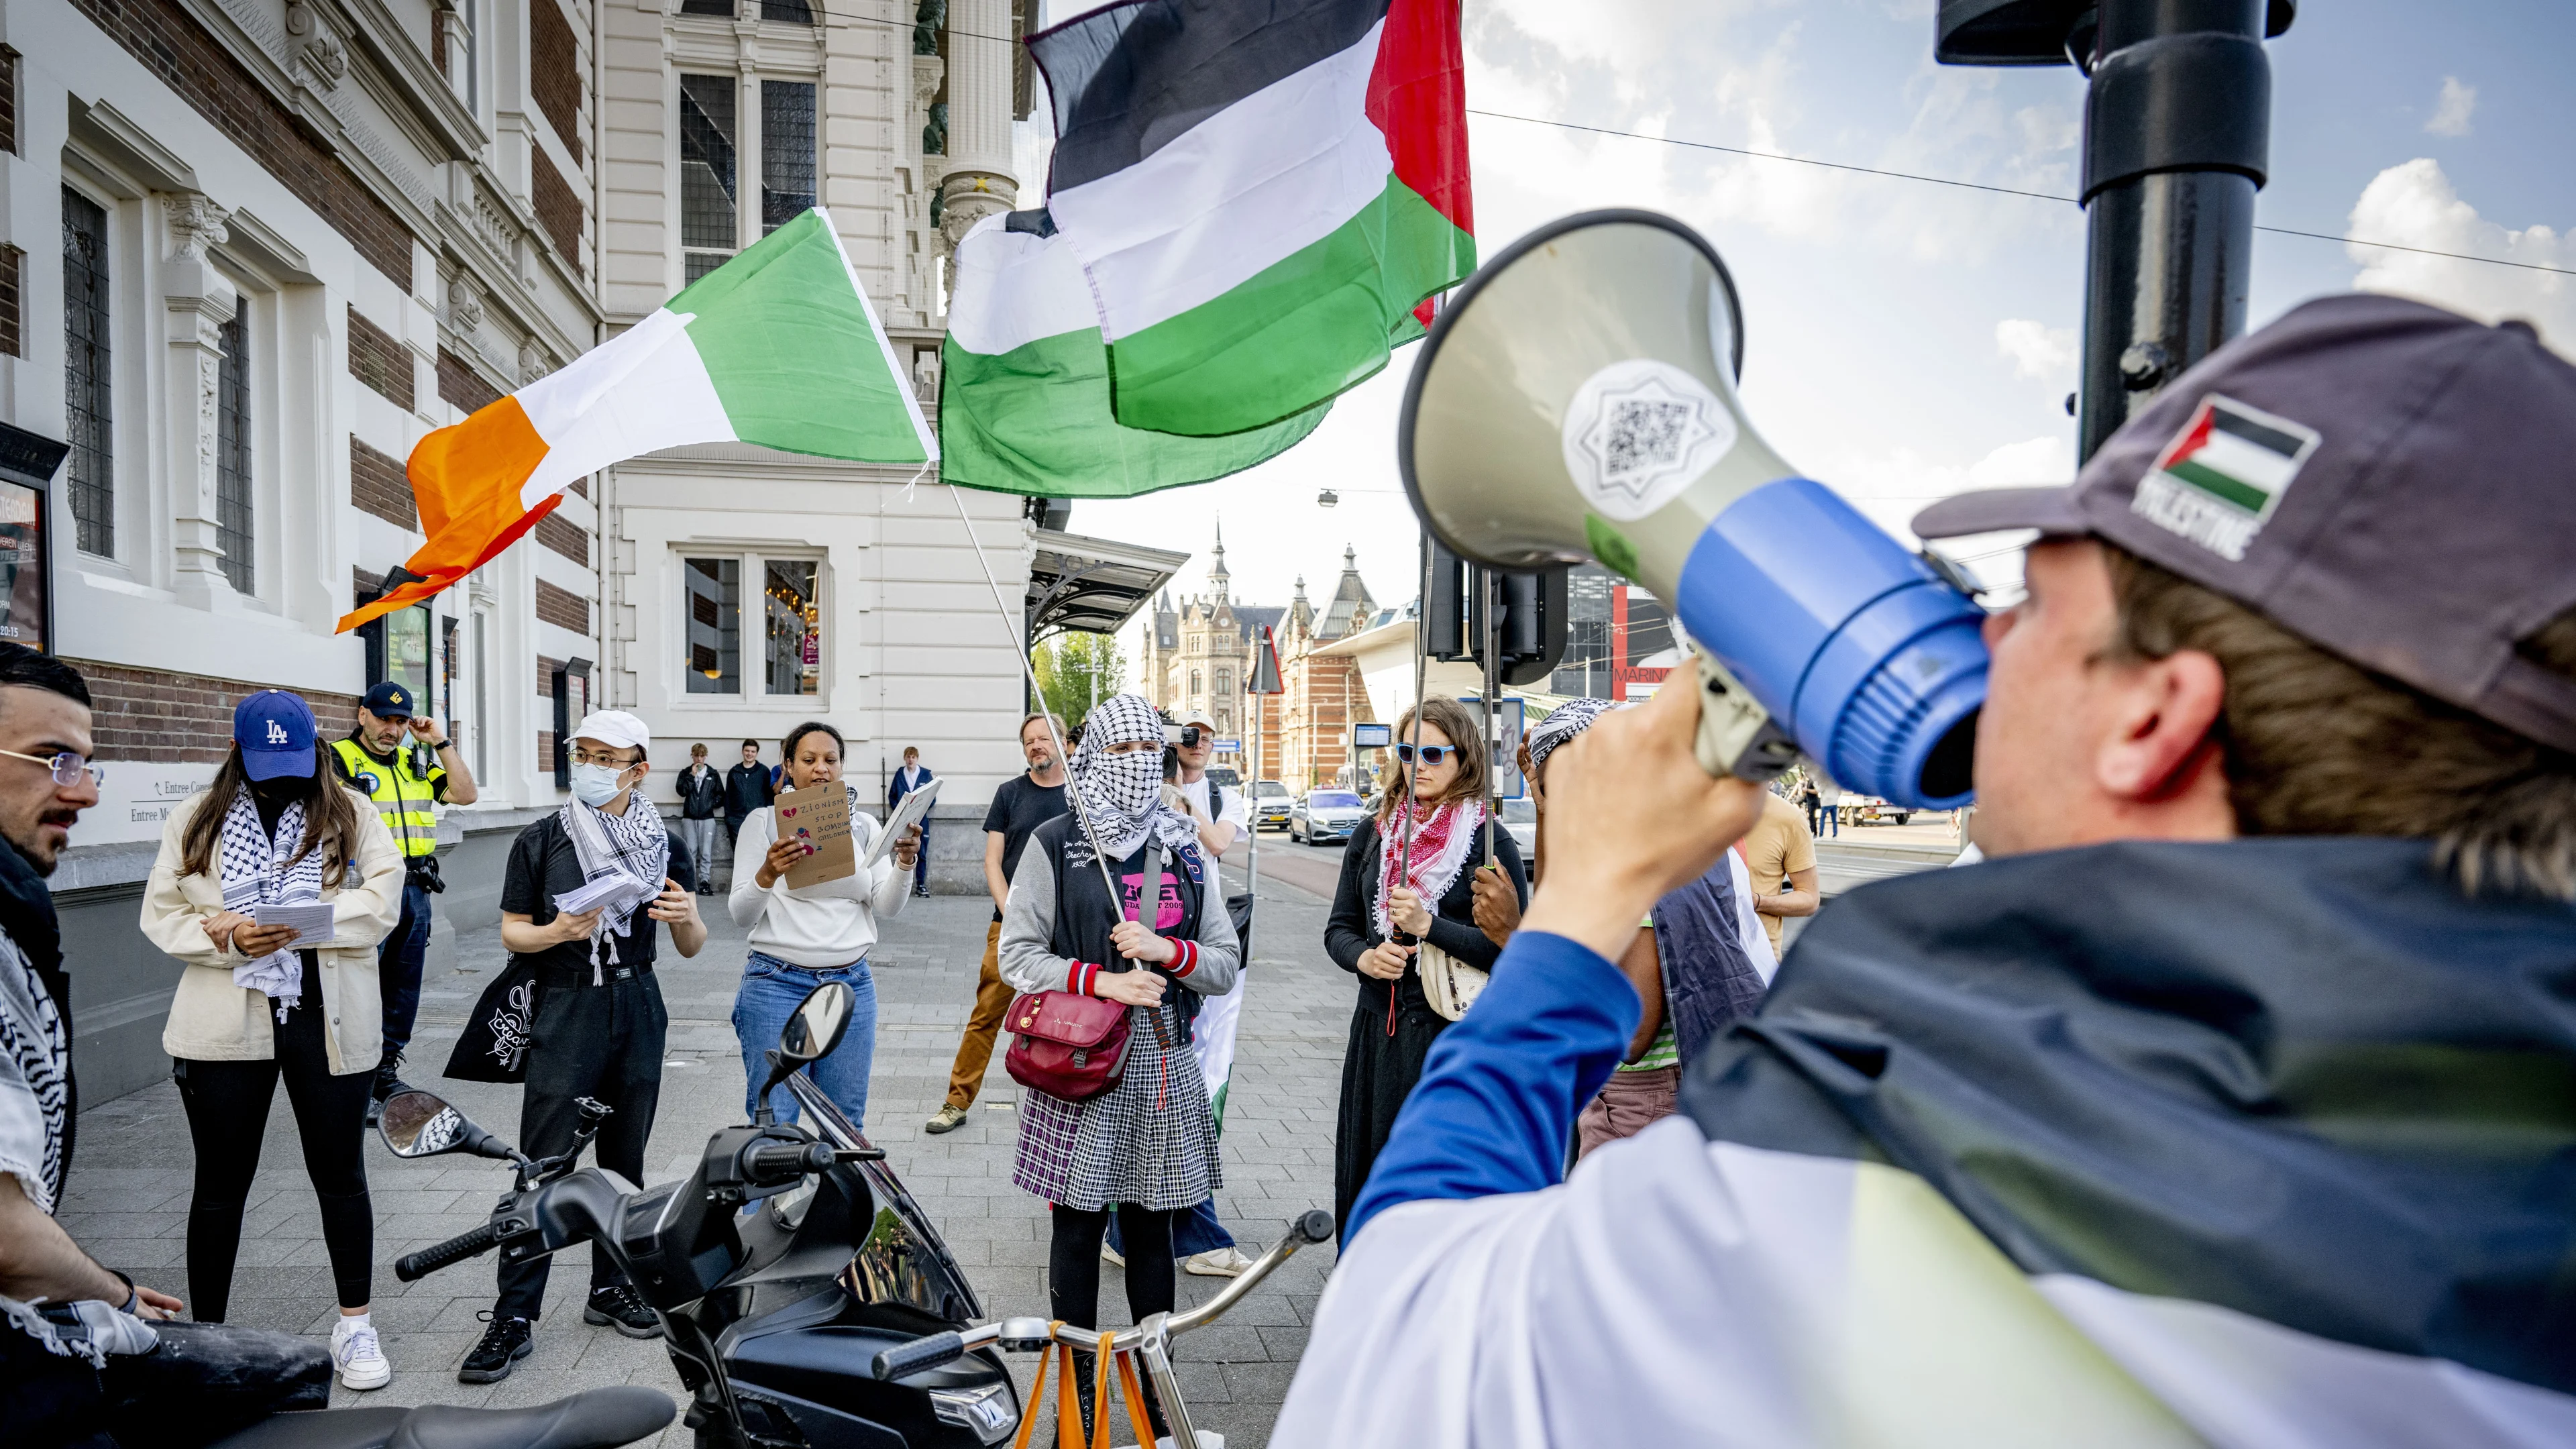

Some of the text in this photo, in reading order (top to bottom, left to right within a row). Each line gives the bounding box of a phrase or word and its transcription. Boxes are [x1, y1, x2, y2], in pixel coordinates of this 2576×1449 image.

[0, 496, 36, 526] TERDAM
[17, 540, 32, 552] WIEN
[0, 625, 19, 637] 20:15
[266, 720, 288, 744] LA
[165, 782, 189, 794] Entree
[131, 808, 158, 822] Entree
[815, 812, 842, 822] STOP
[817, 820, 851, 833] BOMBING
[818, 829, 850, 841] CHILDREN
[1179, 843, 1205, 884] S
[1063, 1020, 1083, 1028] VAUDE
